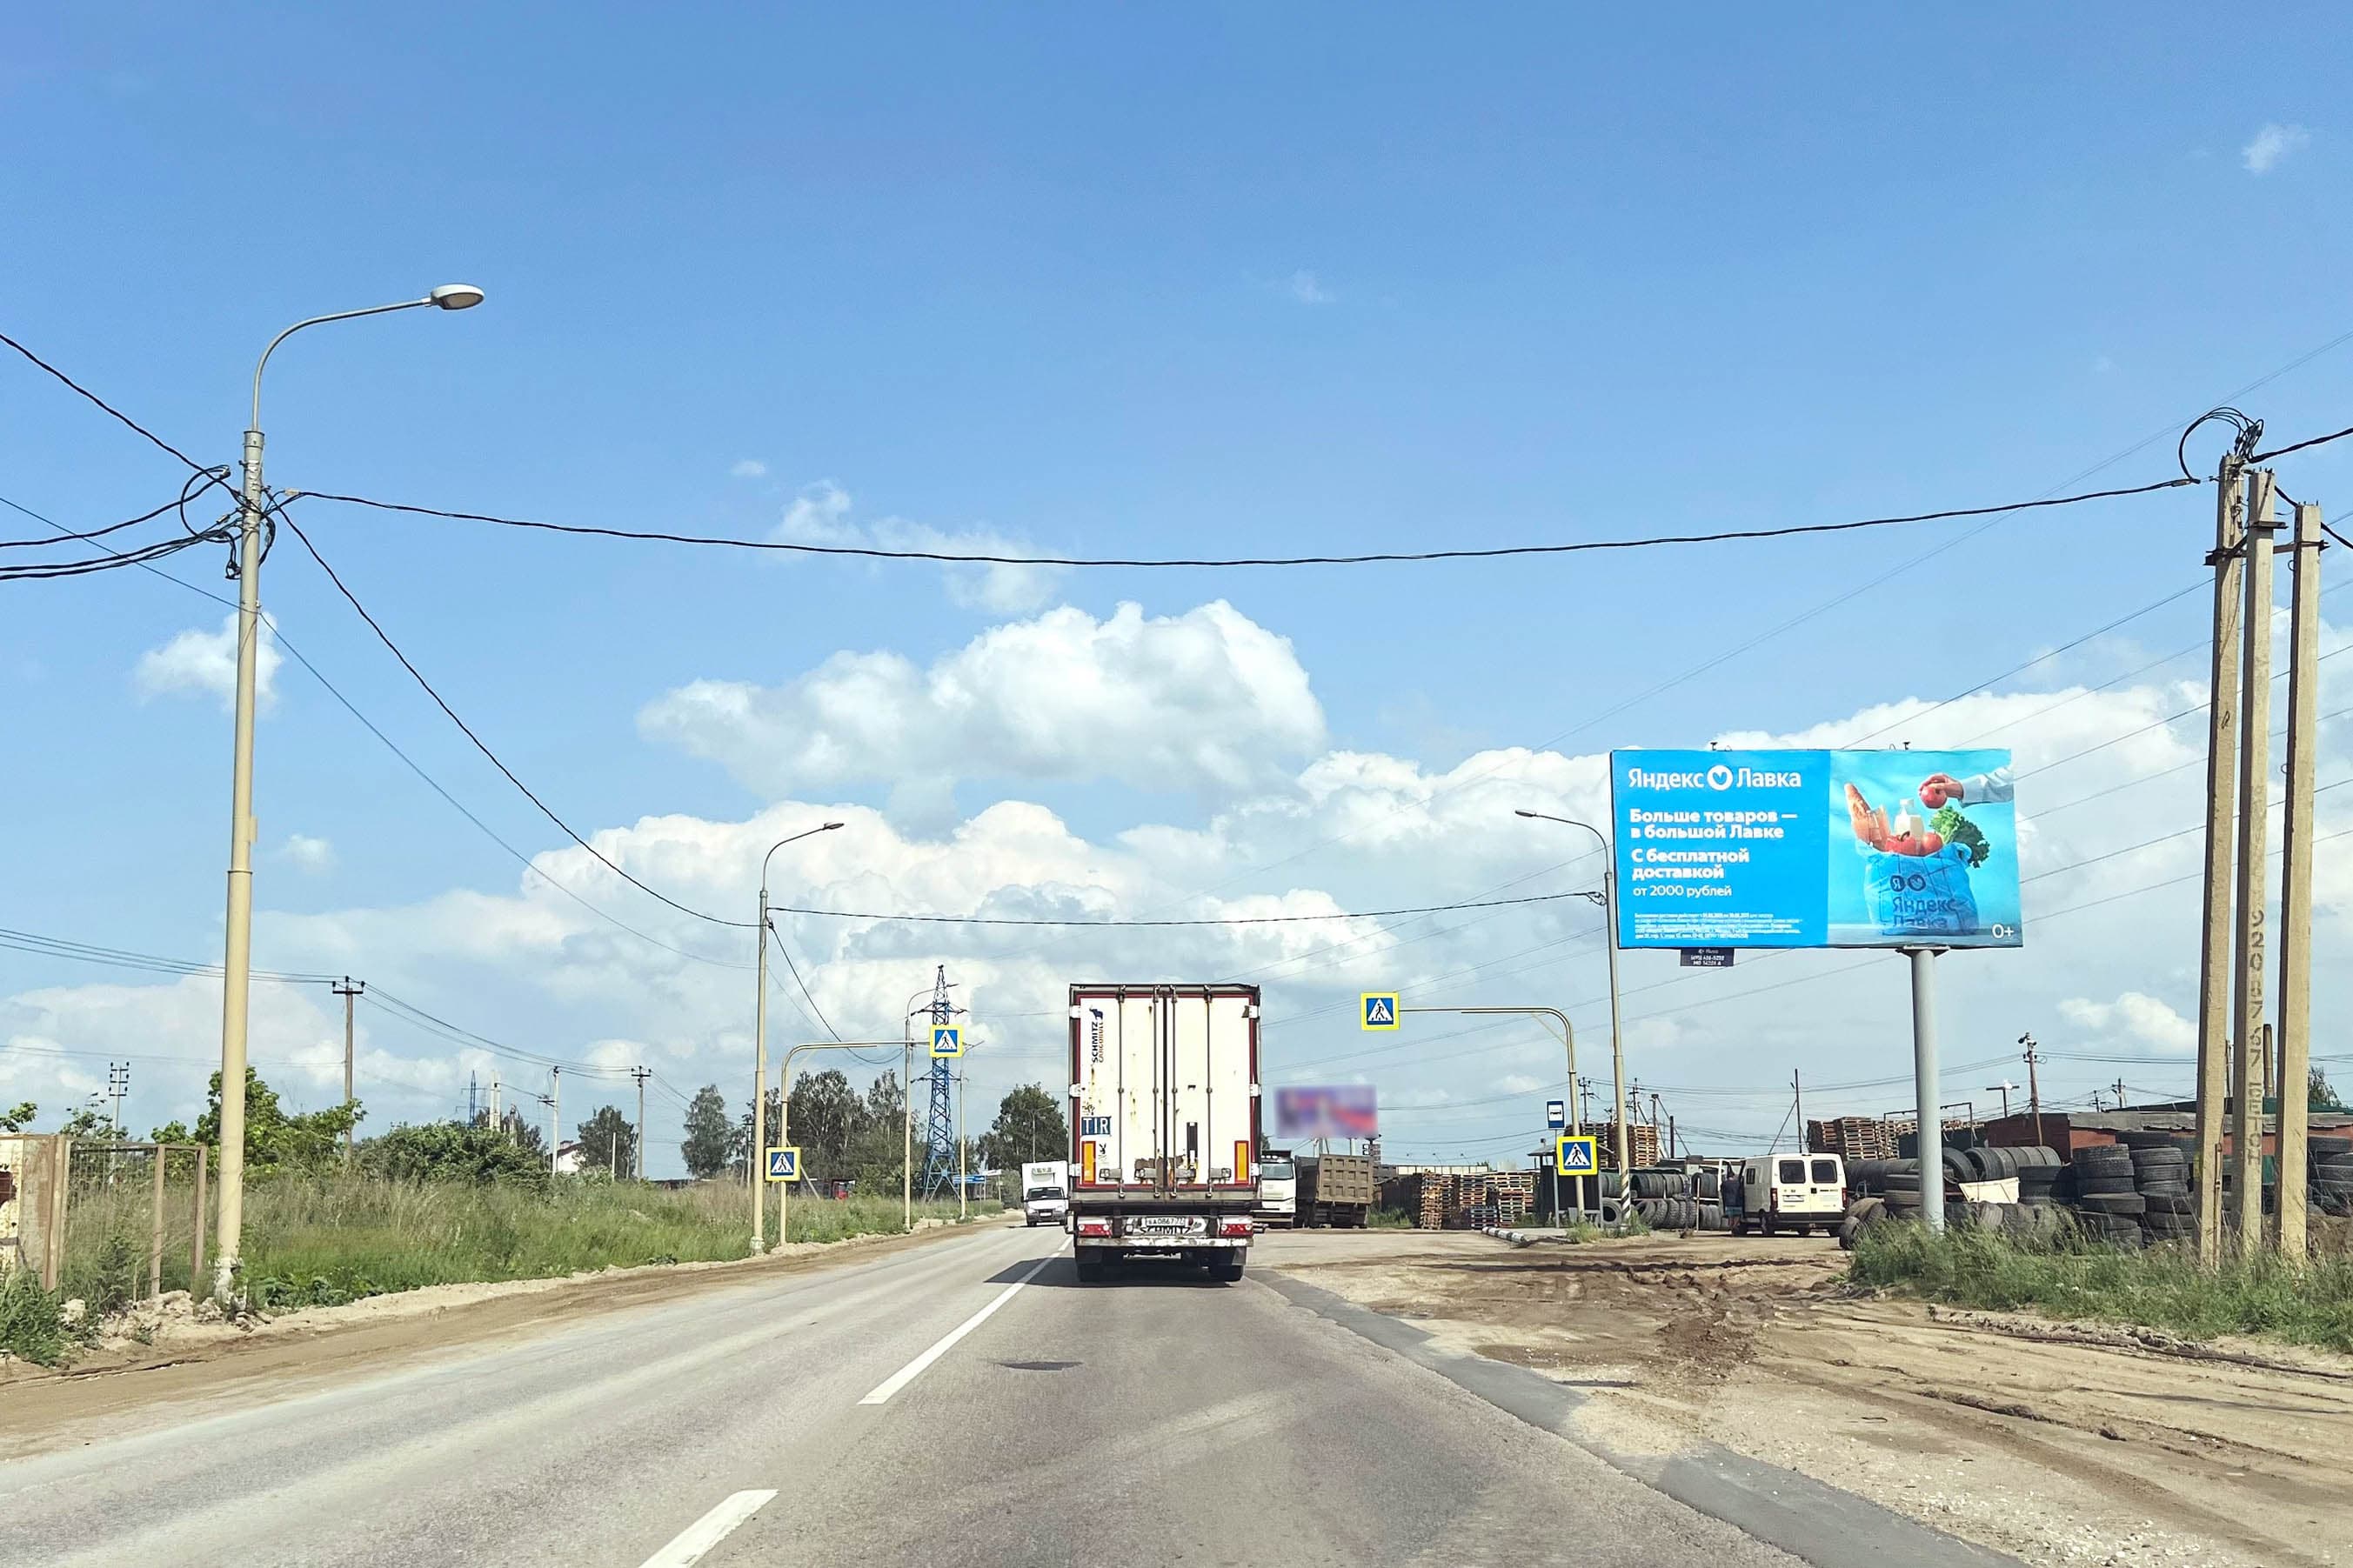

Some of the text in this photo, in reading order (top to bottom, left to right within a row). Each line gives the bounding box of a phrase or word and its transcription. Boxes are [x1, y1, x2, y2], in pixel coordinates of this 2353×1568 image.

[1628, 768, 1802, 791] Яндекс Лавка
[1629, 808, 1701, 823] Больше
[1703, 811, 1778, 825] товаров
[1630, 824, 1784, 839] в большой Лавке
[1631, 848, 1749, 863] С бесплатной
[1632, 864, 1725, 881] доставкой
[1633, 885, 1732, 897] от 2000 рублей
[1892, 897, 1957, 916] Яндекс
[1991, 924, 2015, 938] 0+
[1083, 1118, 1109, 1134] TIR
